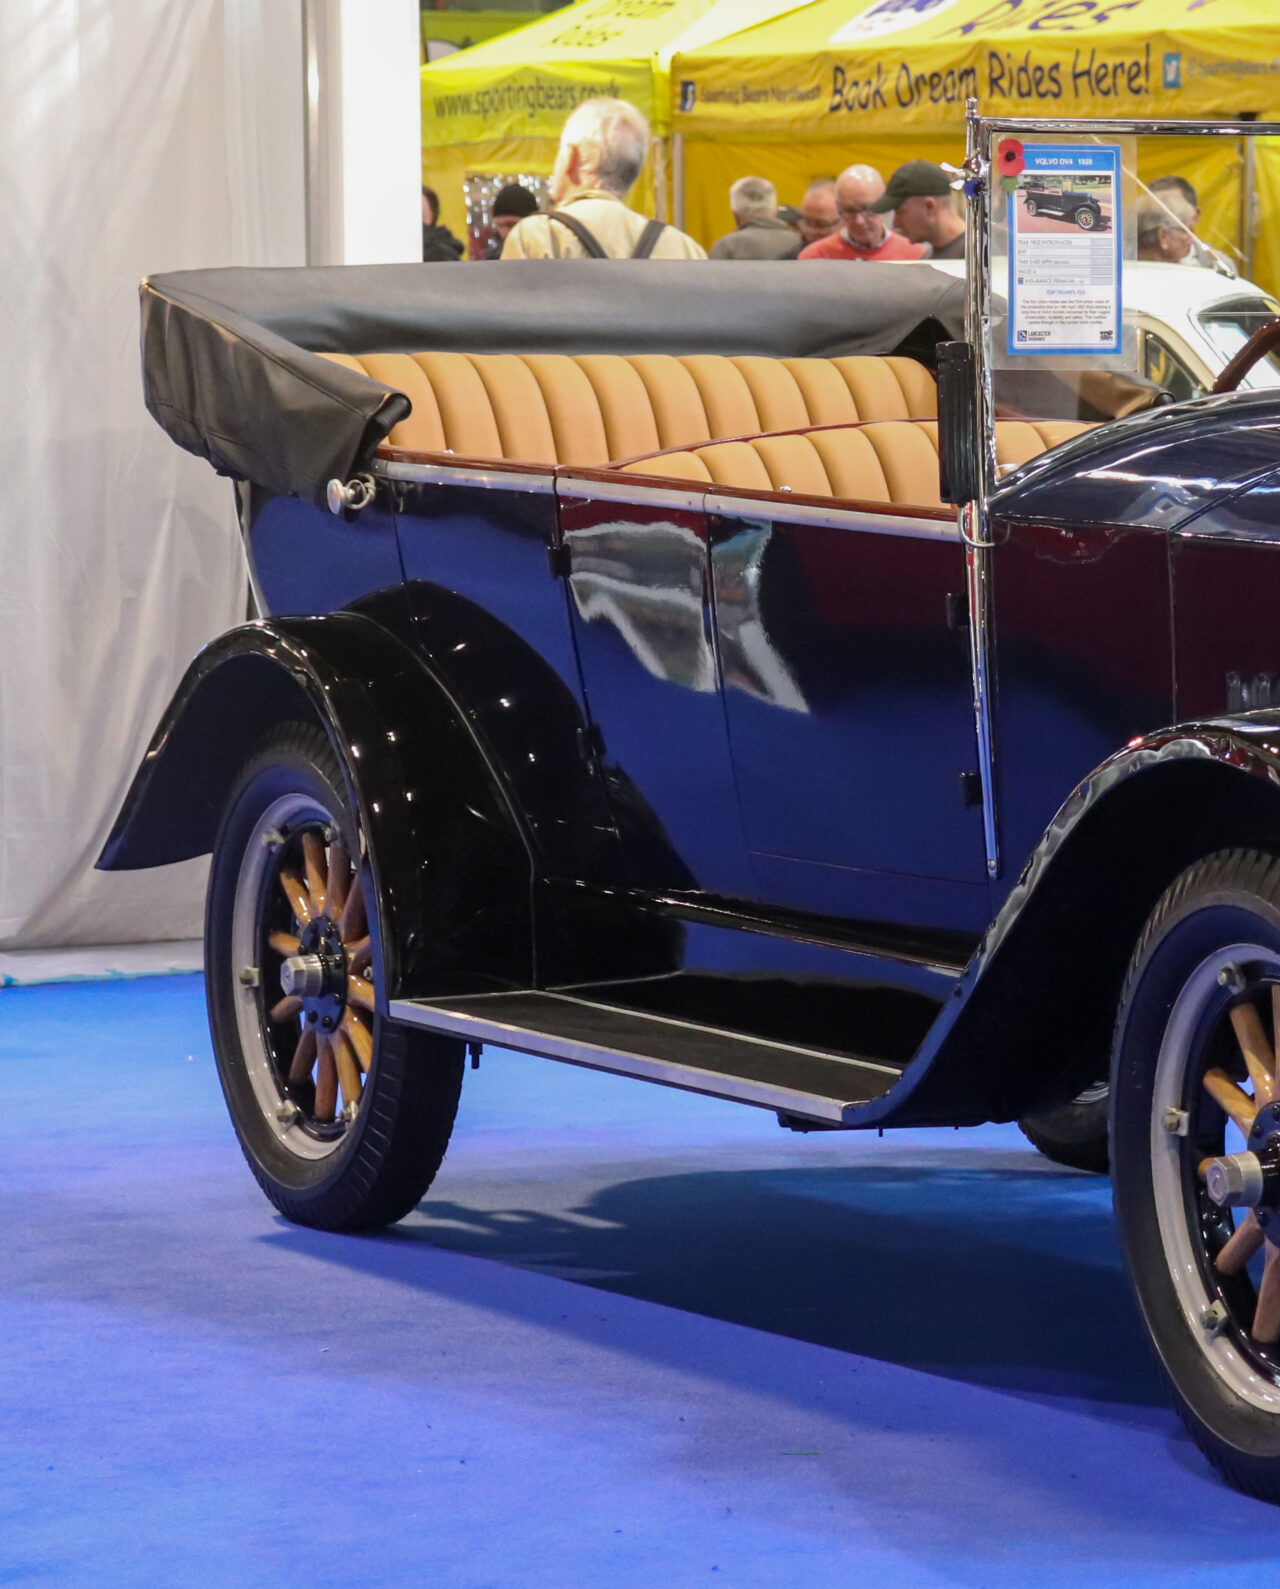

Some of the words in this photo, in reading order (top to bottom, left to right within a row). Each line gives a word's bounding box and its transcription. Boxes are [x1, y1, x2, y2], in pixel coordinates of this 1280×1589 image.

[829, 62, 887, 112] Book
[988, 50, 1062, 99] Rides
[1073, 43, 1150, 98] Here!
